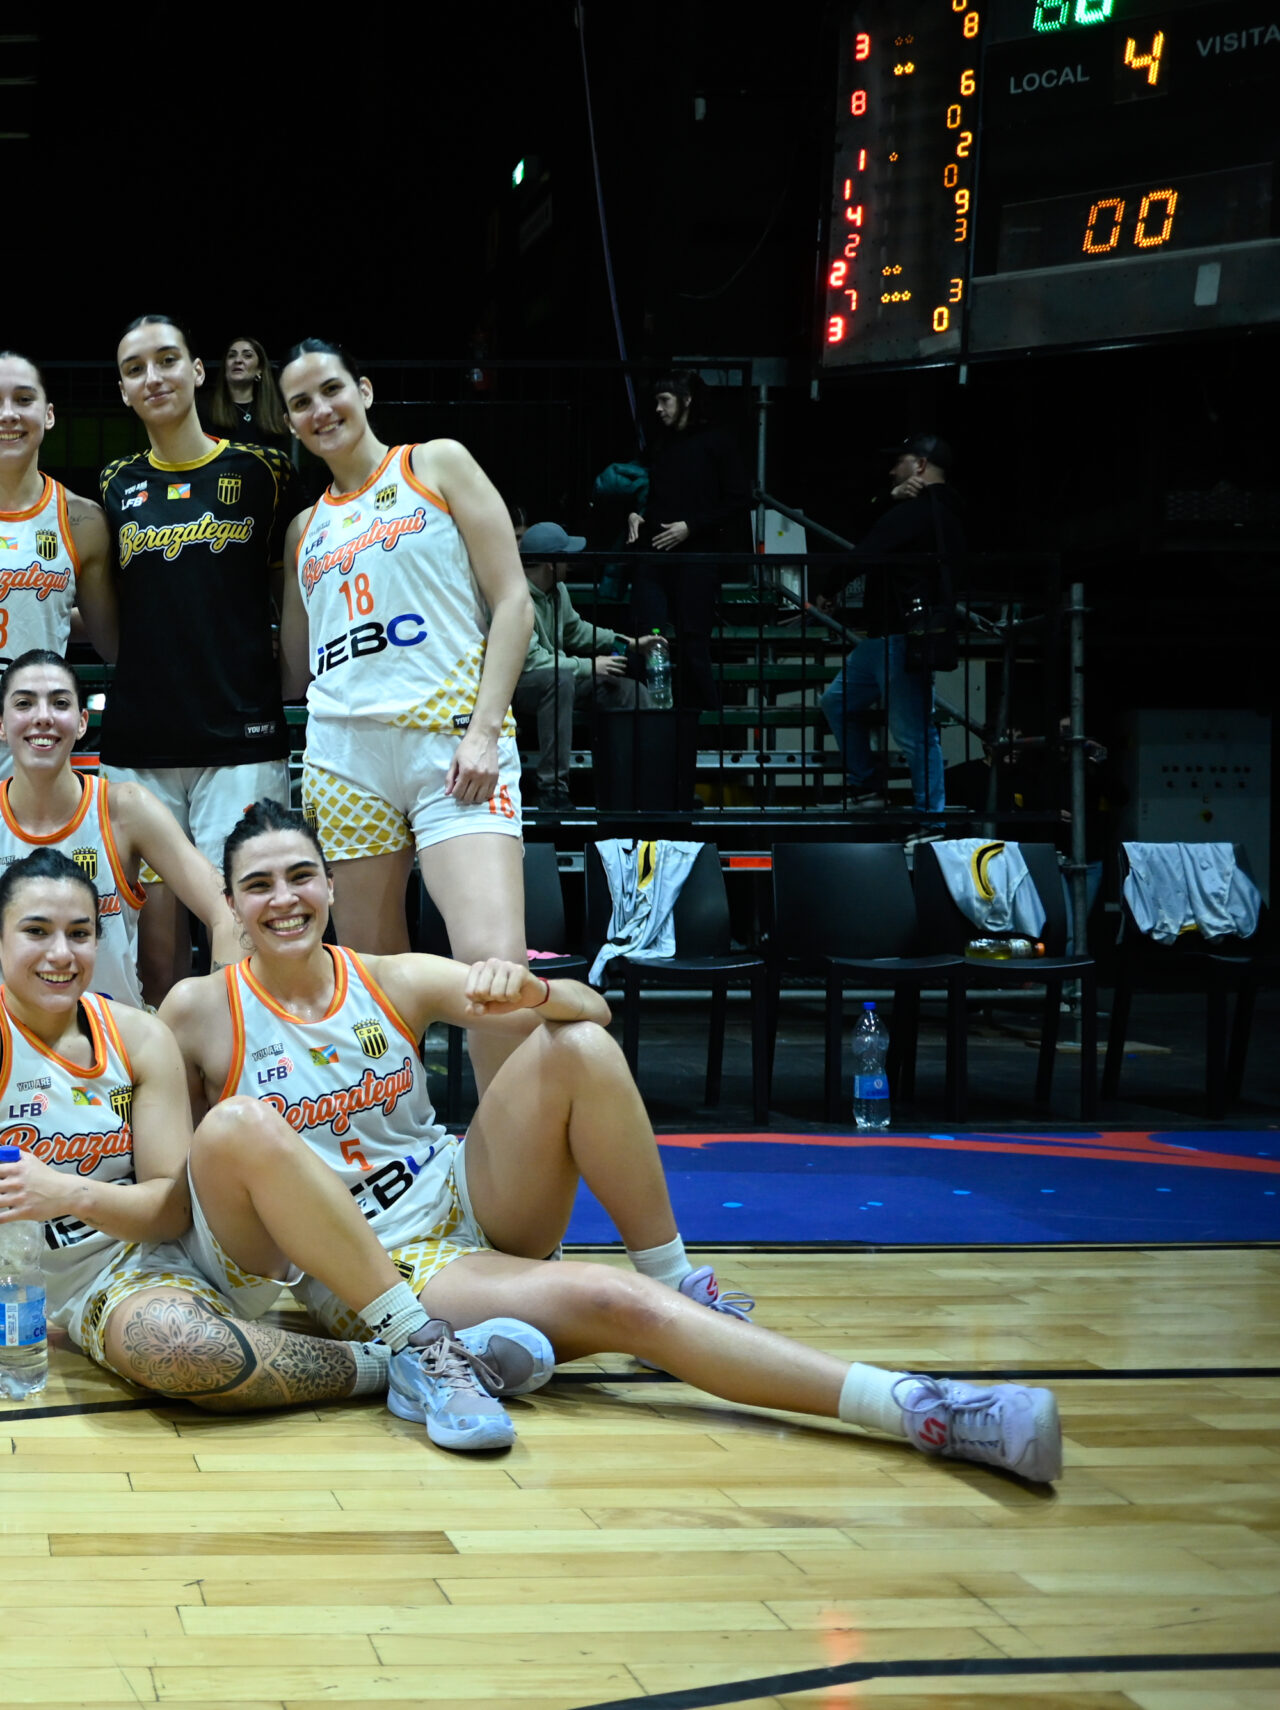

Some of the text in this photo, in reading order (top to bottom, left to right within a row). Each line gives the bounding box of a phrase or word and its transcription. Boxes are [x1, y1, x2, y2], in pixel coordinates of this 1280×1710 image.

[1124, 30, 1165, 86] 4
[1009, 64, 1090, 95] LOCAL
[121, 496, 143, 511] LFB
[120, 511, 255, 569] Berazategui
[302, 507, 426, 604] Berazategui
[305, 535, 324, 555] LFB
[339, 572, 374, 621] 18
[257, 1065, 288, 1084] LFB
[9, 1102, 42, 1118] LFB
[339, 1138, 374, 1171] 5
